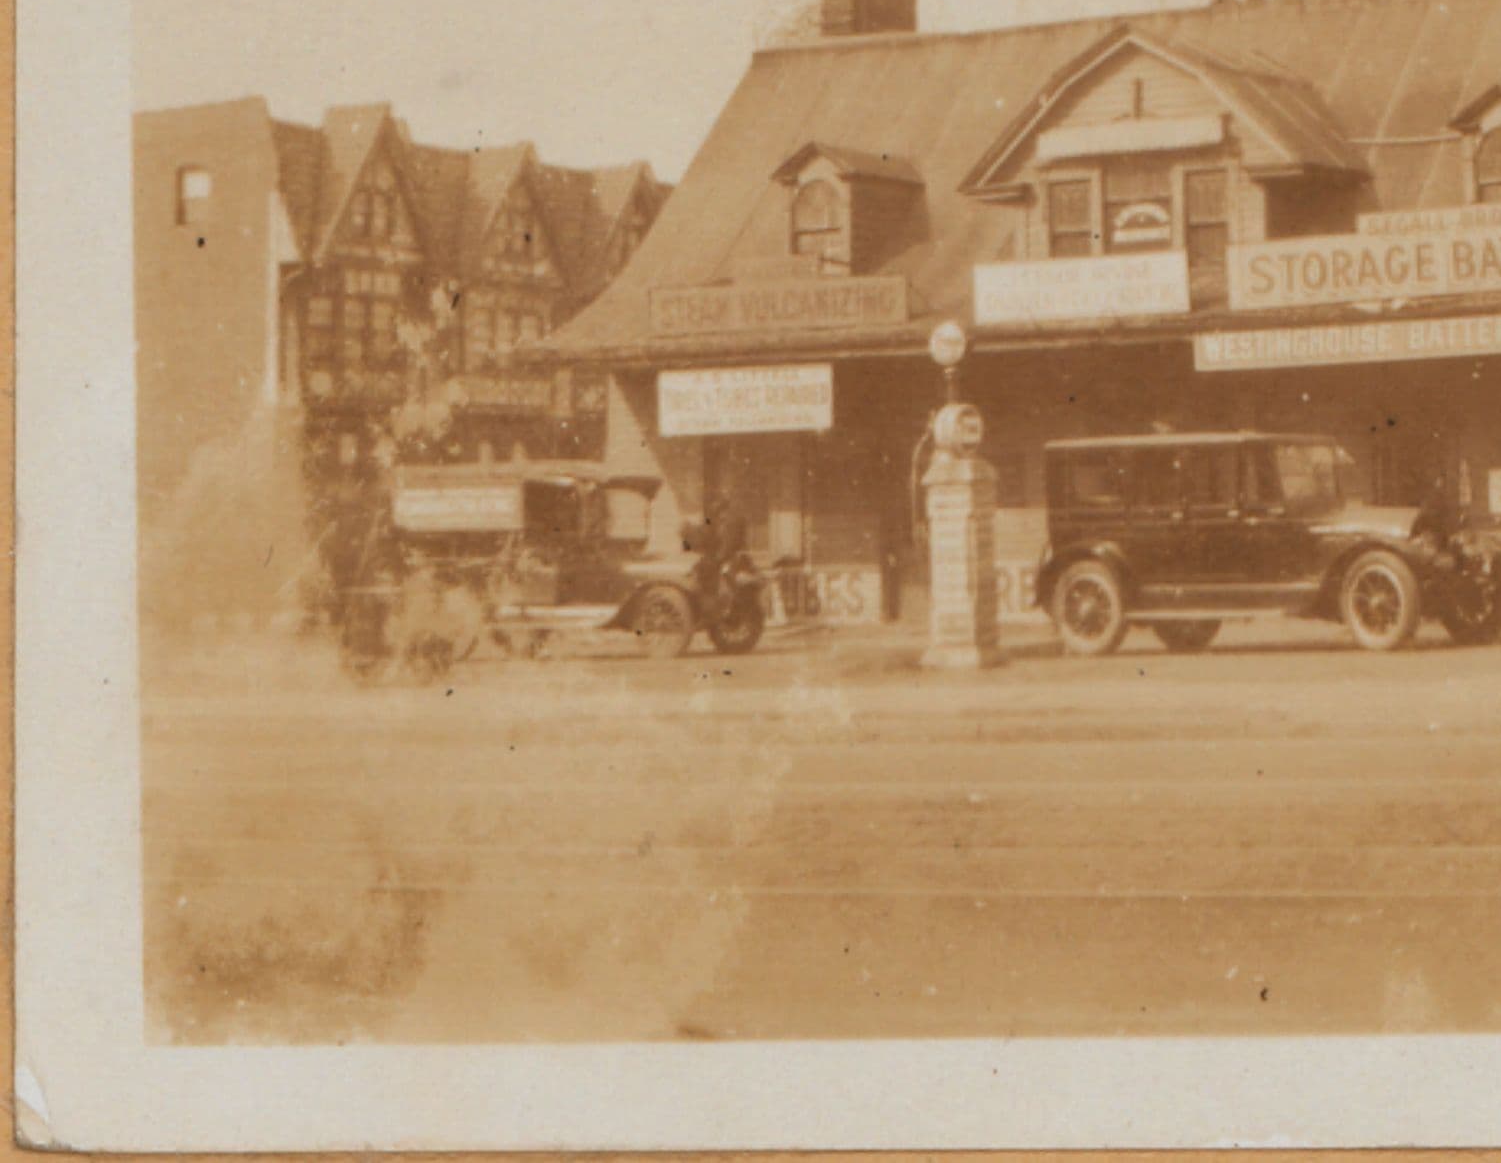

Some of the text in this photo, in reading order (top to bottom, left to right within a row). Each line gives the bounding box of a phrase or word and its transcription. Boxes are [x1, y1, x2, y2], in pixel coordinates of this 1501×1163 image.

[1248, 243, 1438, 294] STORAGE
[660, 285, 898, 327] STEAM VULCANIZING
[1203, 324, 1393, 362] WESTINGHOUSE
